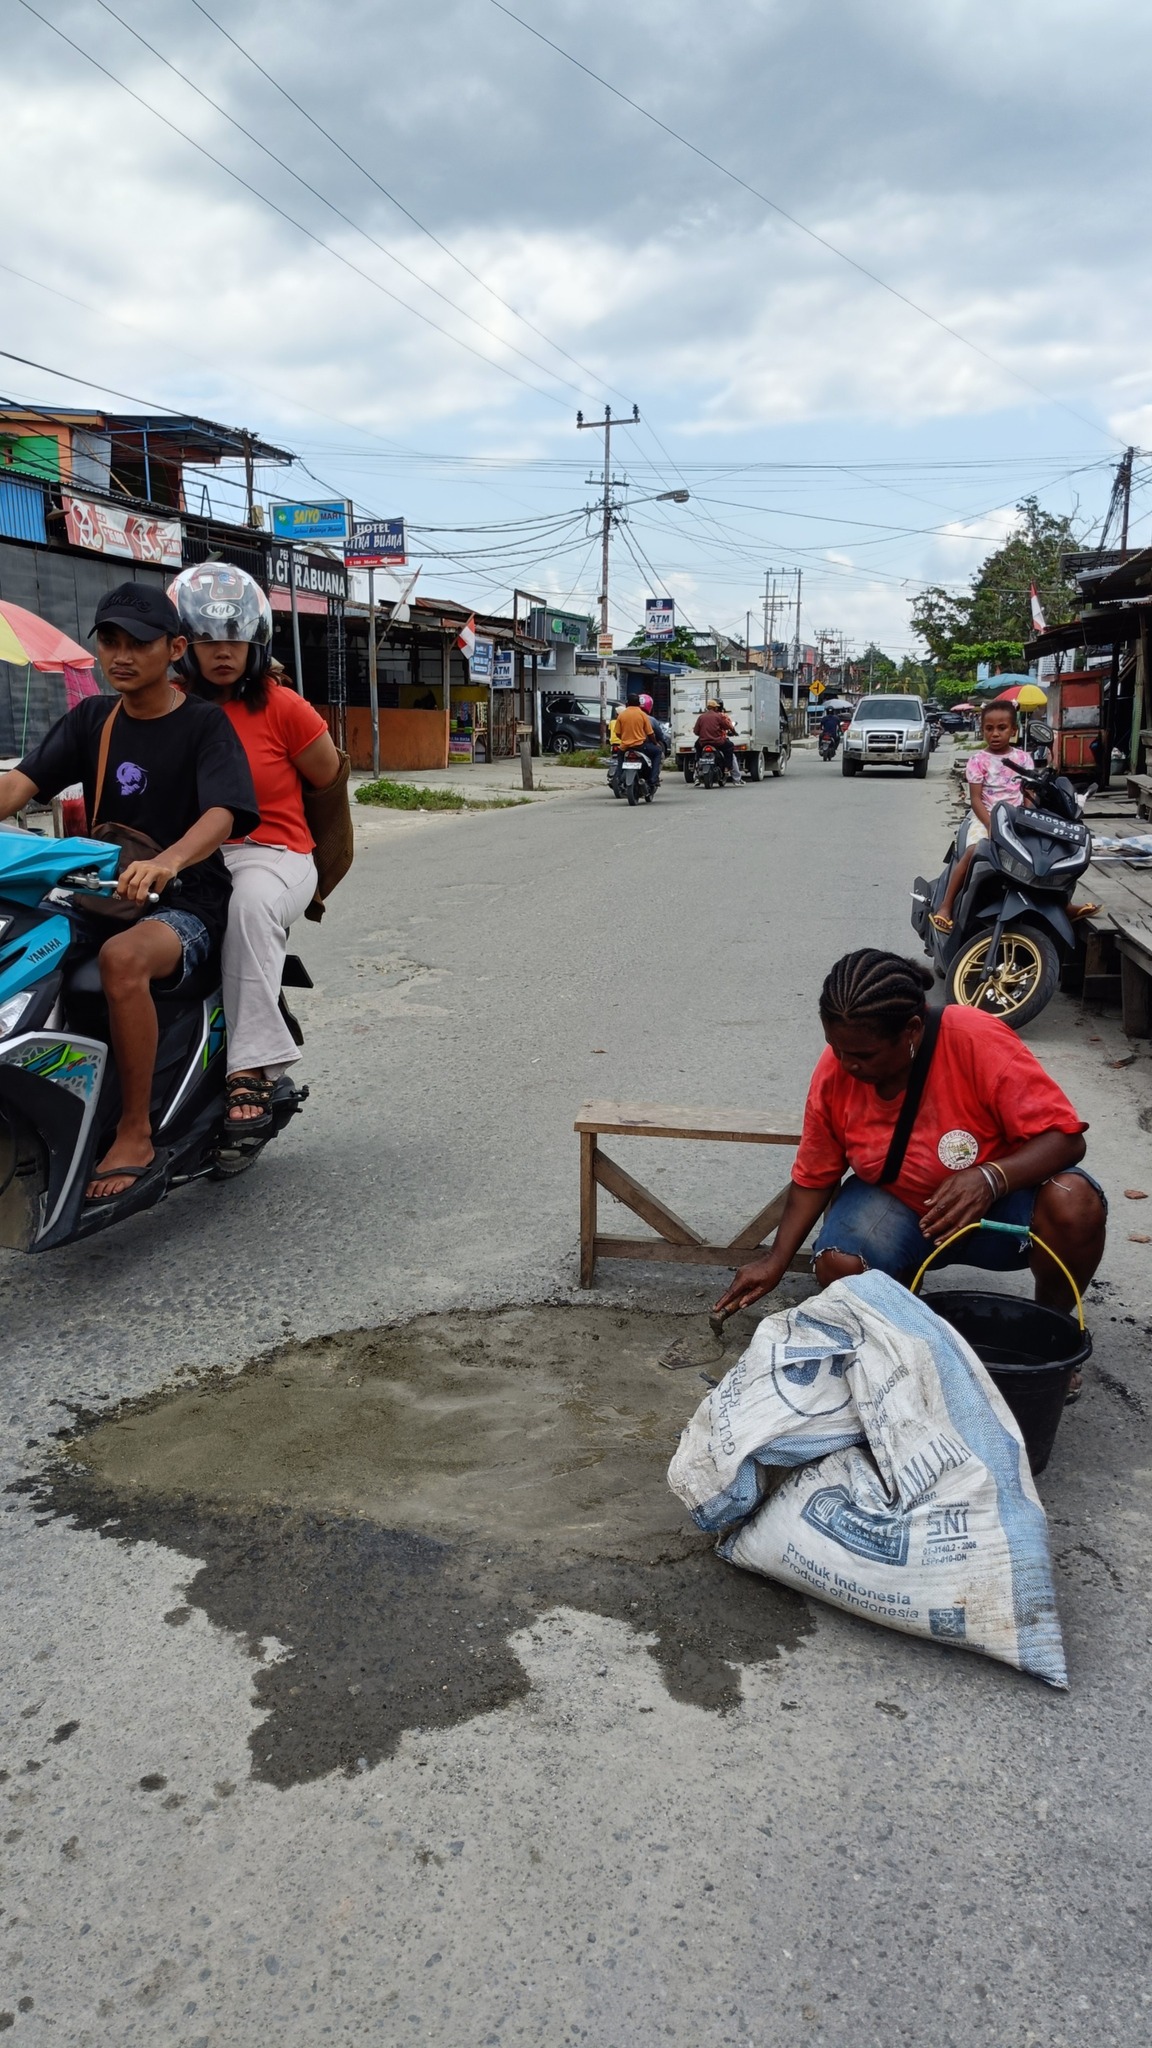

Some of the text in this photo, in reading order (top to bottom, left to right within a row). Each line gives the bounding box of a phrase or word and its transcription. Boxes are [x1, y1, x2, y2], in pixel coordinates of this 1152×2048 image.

[293, 509, 320, 524] SAIYO
[320, 512, 342, 520] MART
[356, 523, 391, 534] HOTEL
[373, 533, 403, 548] BUANA
[275, 559, 346, 598] CIRABUANA
[649, 614, 670, 624] ATM
[493, 666, 510, 675] ATM
[27, 937, 63, 964] YAMAHA
[837, 1517, 897, 1547] INDONESIA
[926, 1508, 969, 1536] SNI
[781, 1554, 919, 1619] Product of Indonesia
[787, 1542, 911, 1606] Produk Indonesia
